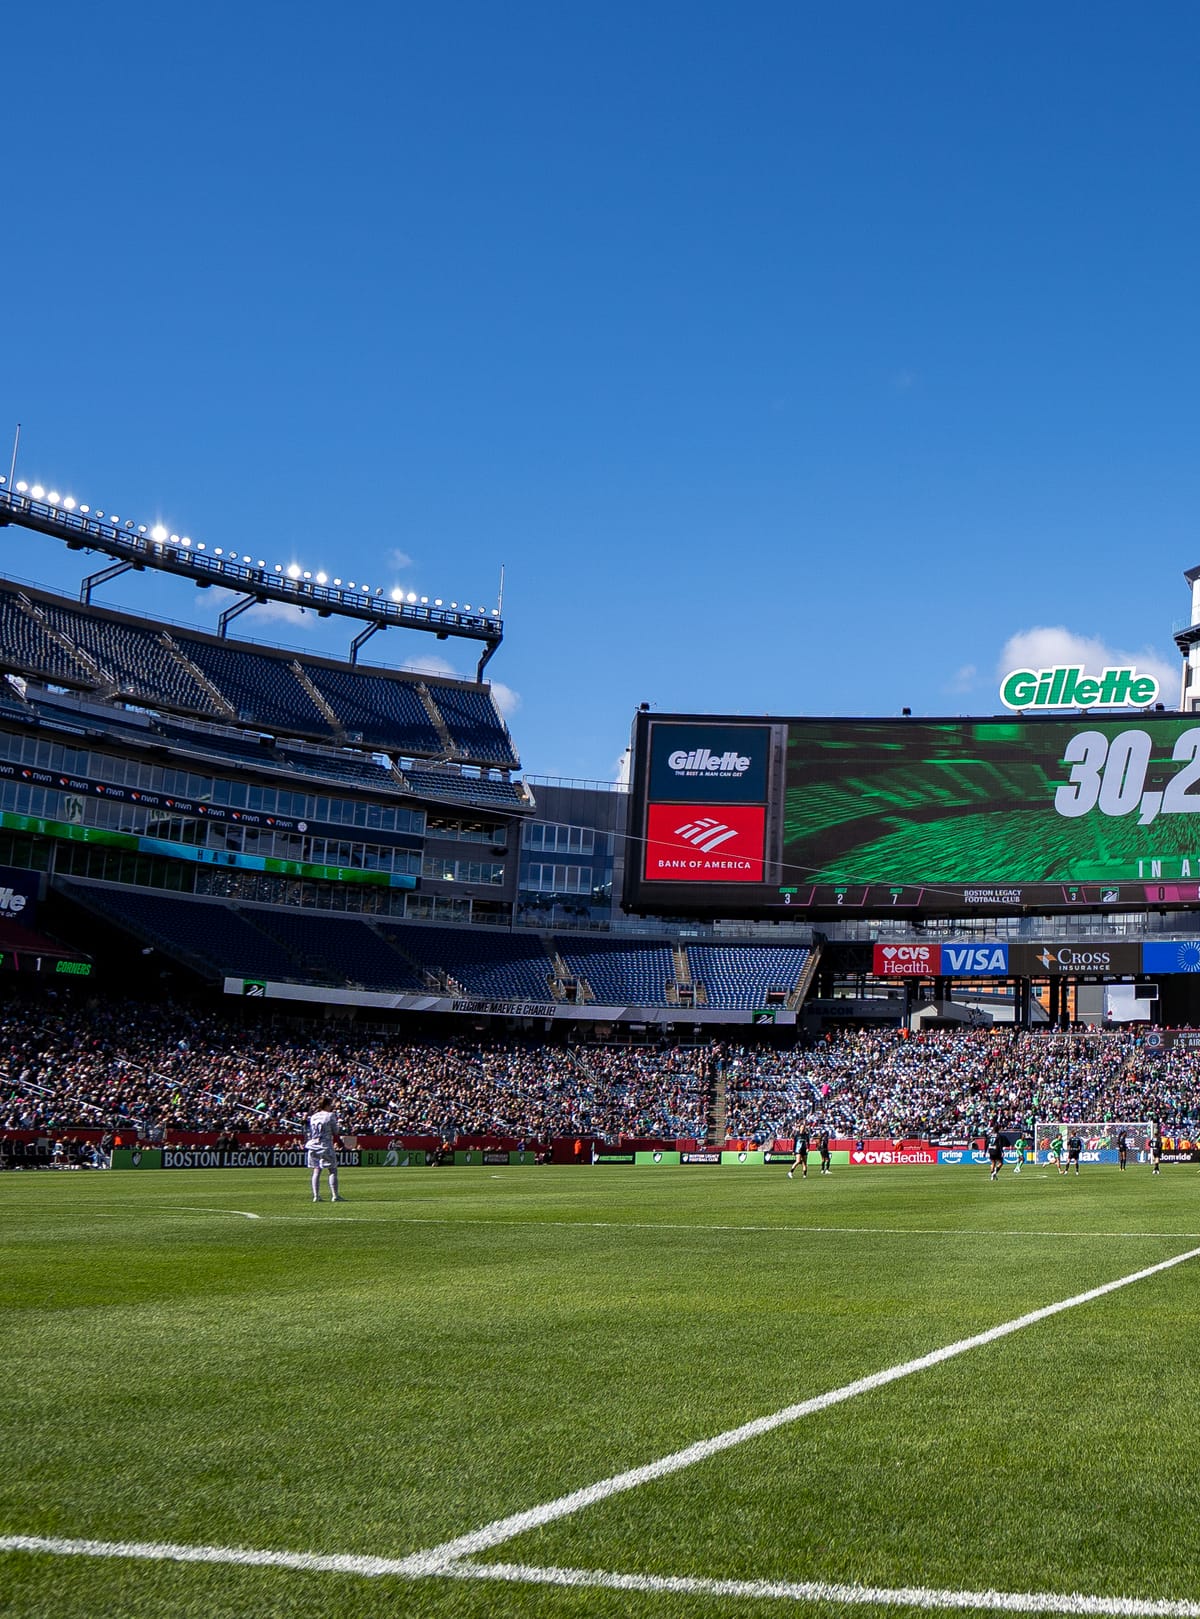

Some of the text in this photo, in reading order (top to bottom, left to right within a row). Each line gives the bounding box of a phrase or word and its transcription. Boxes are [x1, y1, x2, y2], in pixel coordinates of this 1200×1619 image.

[1003, 667, 1156, 706] Gillette
[668, 749, 750, 771] Gillette
[658, 860, 686, 868] BANK
[704, 861, 751, 869] AMERICA
[1138, 859, 1161, 878] IN
[784, 894, 791, 904] 3
[837, 894, 844, 904] 2
[892, 894, 898, 904] 7
[897, 947, 929, 960] CVS
[944, 949, 1006, 970] VISA
[36, 957, 91, 975] 1 CORNERS
[452, 1000, 488, 1011] WELCOME
[489, 1002, 517, 1014] MAEVE
[523, 1004, 556, 1016] CHARLIE!
[1188, 1038, 1200, 1046] AIR
[164, 1151, 221, 1167] BOSTON
[224, 1151, 269, 1167] LEGACY
[273, 1151, 308, 1167] FOOT
[942, 1151, 962, 1159] prime
